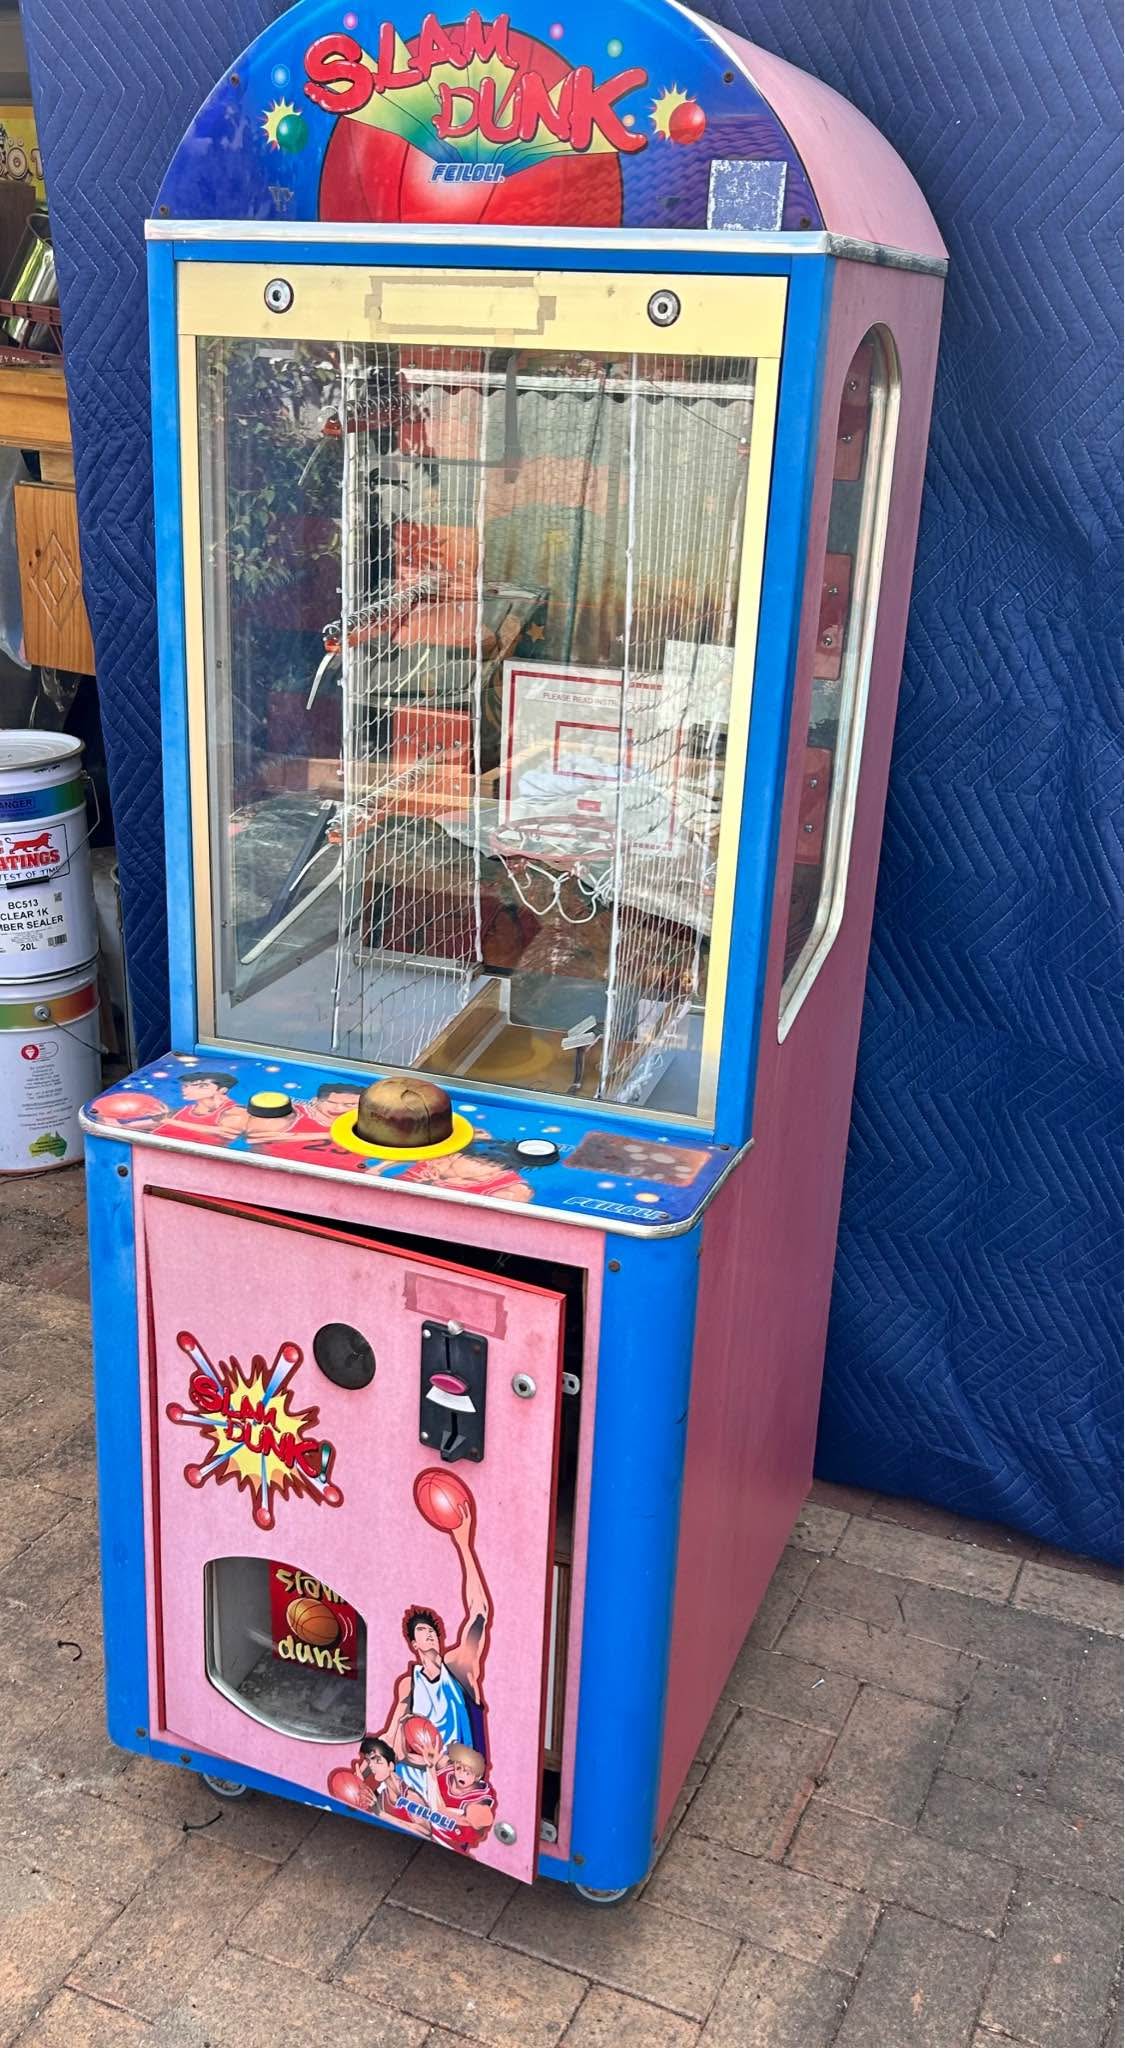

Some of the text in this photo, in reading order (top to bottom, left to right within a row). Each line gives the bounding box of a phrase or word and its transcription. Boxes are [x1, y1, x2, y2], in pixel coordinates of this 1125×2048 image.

[304, 10, 519, 118] SLAM
[432, 66, 648, 152] DUNK
[543, 692, 571, 701] PLEASE
[573, 695, 593, 704] READ
[26, 870, 37, 879] OF
[8, 899, 39, 909] BC513
[0, 907, 49, 921] CLEAR 1K
[26, 914, 64, 929] SEALER
[20, 942, 38, 951] 20L
[191, 1374, 281, 1434] SLAM
[278, 1634, 352, 1675] dunk
